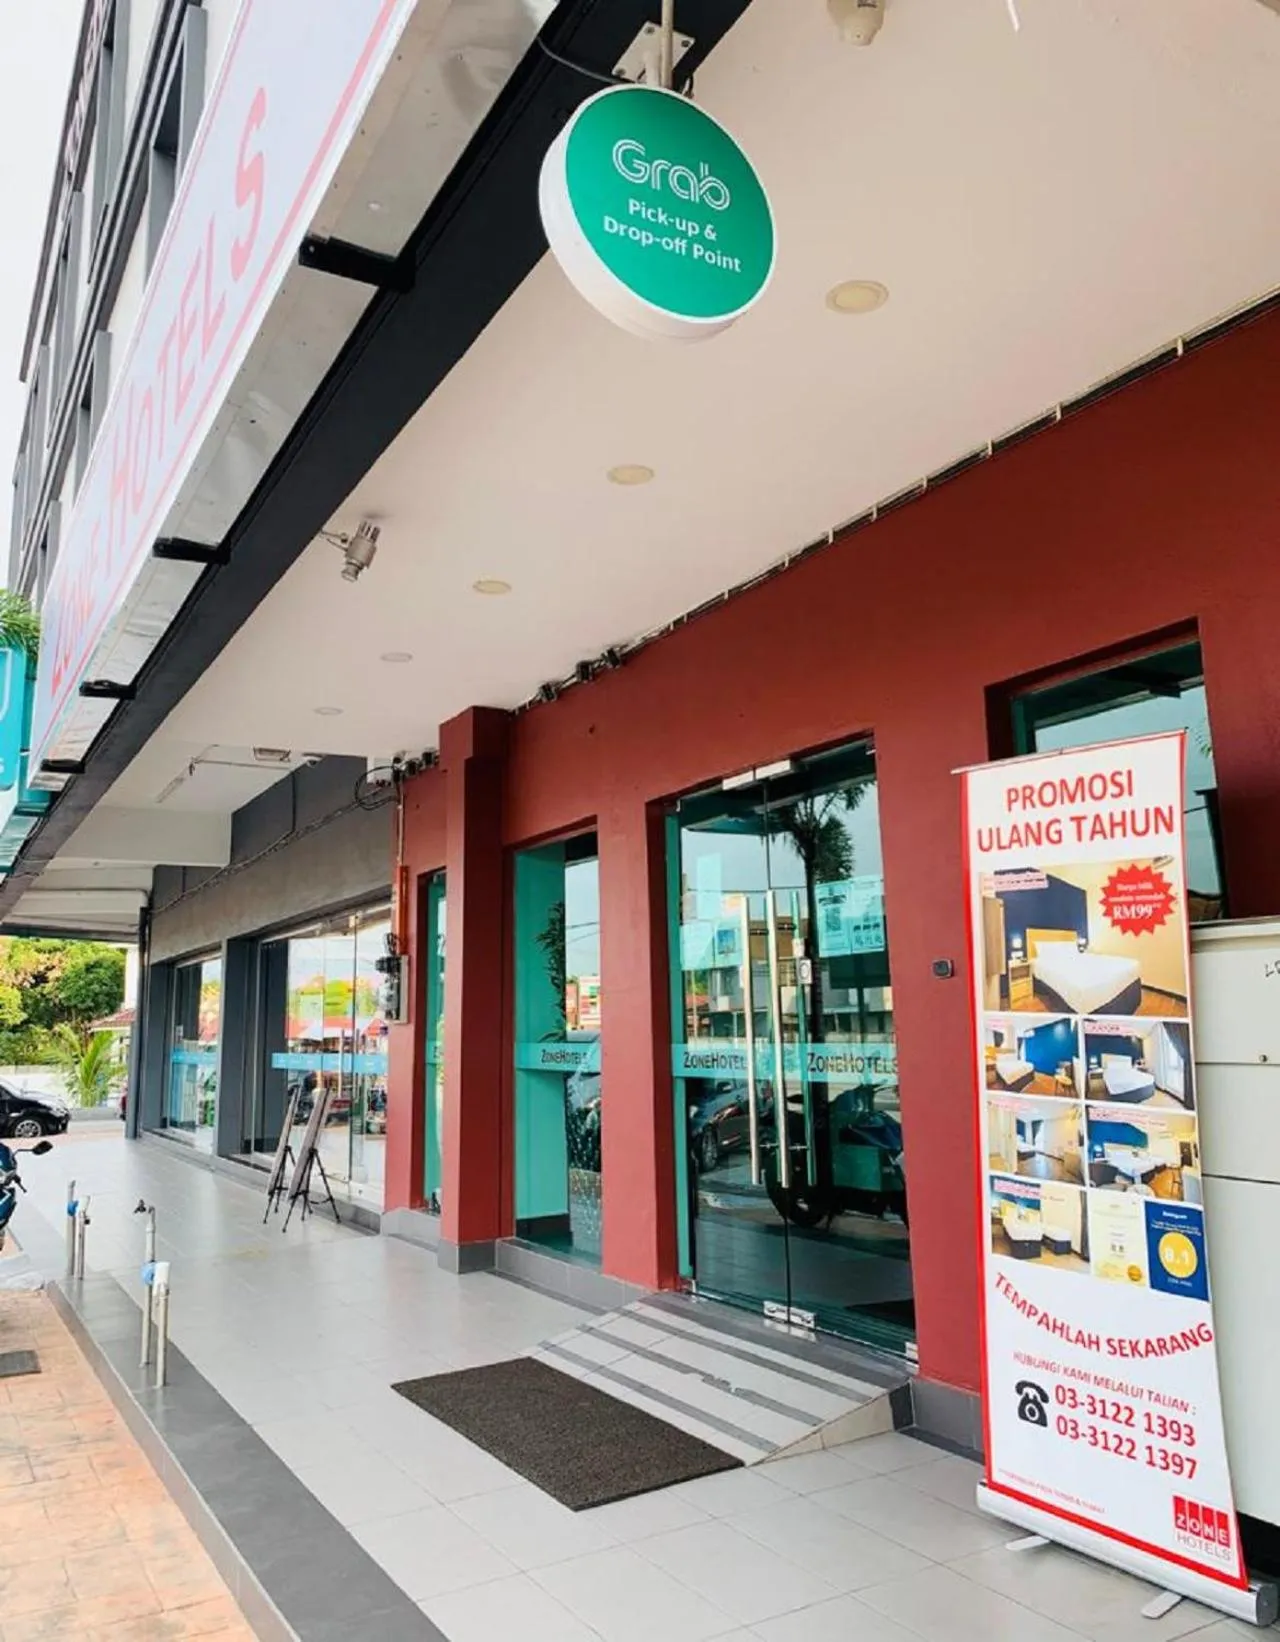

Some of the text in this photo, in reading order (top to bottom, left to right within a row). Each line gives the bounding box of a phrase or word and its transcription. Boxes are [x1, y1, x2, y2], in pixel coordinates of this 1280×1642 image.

[612, 139, 731, 210] Grab
[603, 216, 742, 273] Drop-off Point
[628, 199, 718, 241] Pick-up &
[1006, 769, 1134, 812] PROMOSI
[977, 805, 1175, 852] ULANG TAHUN
[994, 1272, 1214, 1360] TEMPAHLAH SEKARANG
[1013, 1350, 1061, 1375] HUBUNGI
[1063, 1365, 1091, 1384] KAMI
[1093, 1374, 1144, 1399] MELALUI
[1147, 1390, 1190, 1414] TALIAN
[1055, 1384, 1197, 1448] 03-3122 1393
[1056, 1415, 1198, 1480] 03-3122 1397
[1175, 1515, 1229, 1543] ZONE
[1176, 1534, 1232, 1562] HOTELS
